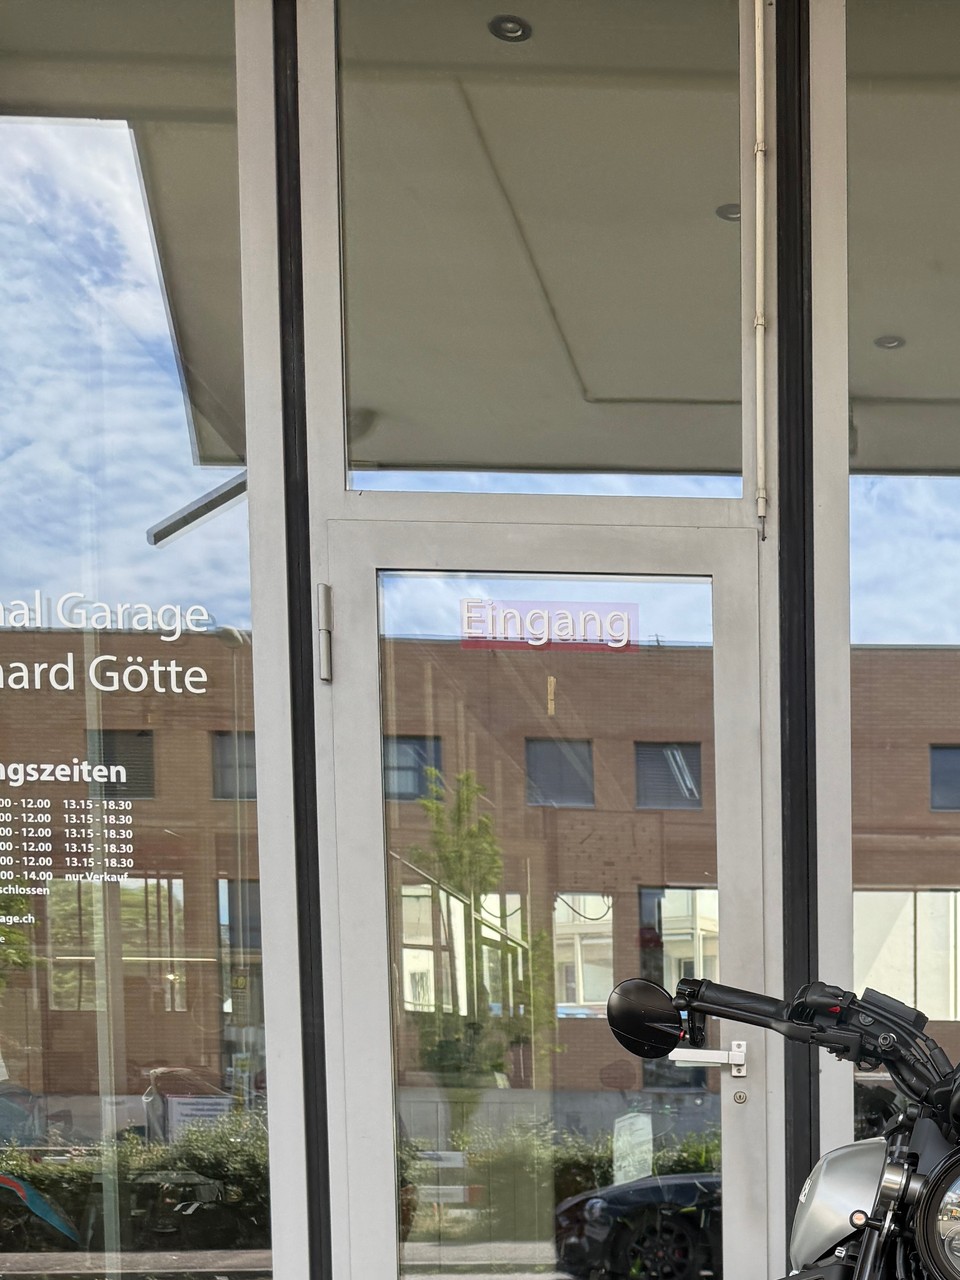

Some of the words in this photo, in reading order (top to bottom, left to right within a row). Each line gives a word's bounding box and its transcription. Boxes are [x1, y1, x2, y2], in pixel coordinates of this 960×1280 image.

[0, 589, 42, 628] al
[56, 592, 210, 642] Garage
[463, 598, 630, 648] Eingang
[0, 652, 75, 691] ard
[88, 655, 208, 694] Götte
[20, 799, 51, 808] 12.00
[63, 799, 93, 809] 13.15
[102, 800, 132, 810] 18.30
[21, 813, 52, 823] 12.00
[63, 814, 94, 824] 13.15
[102, 815, 133, 825] 18.30
[21, 828, 52, 837] 12.00
[64, 829, 94, 838] 13.15
[103, 829, 133, 839] 18.30
[22, 842, 52, 852] 12.00
[64, 843, 95, 853] 13.15
[103, 844, 134, 853] 18.30
[22, 857, 53, 866] 12.00
[65, 857, 95, 867] 13.15
[104, 858, 134, 868] 18.30
[23, 871, 53, 880] 14.00
[65, 873, 84, 881] nur
[85, 872, 129, 882] Verkauf
